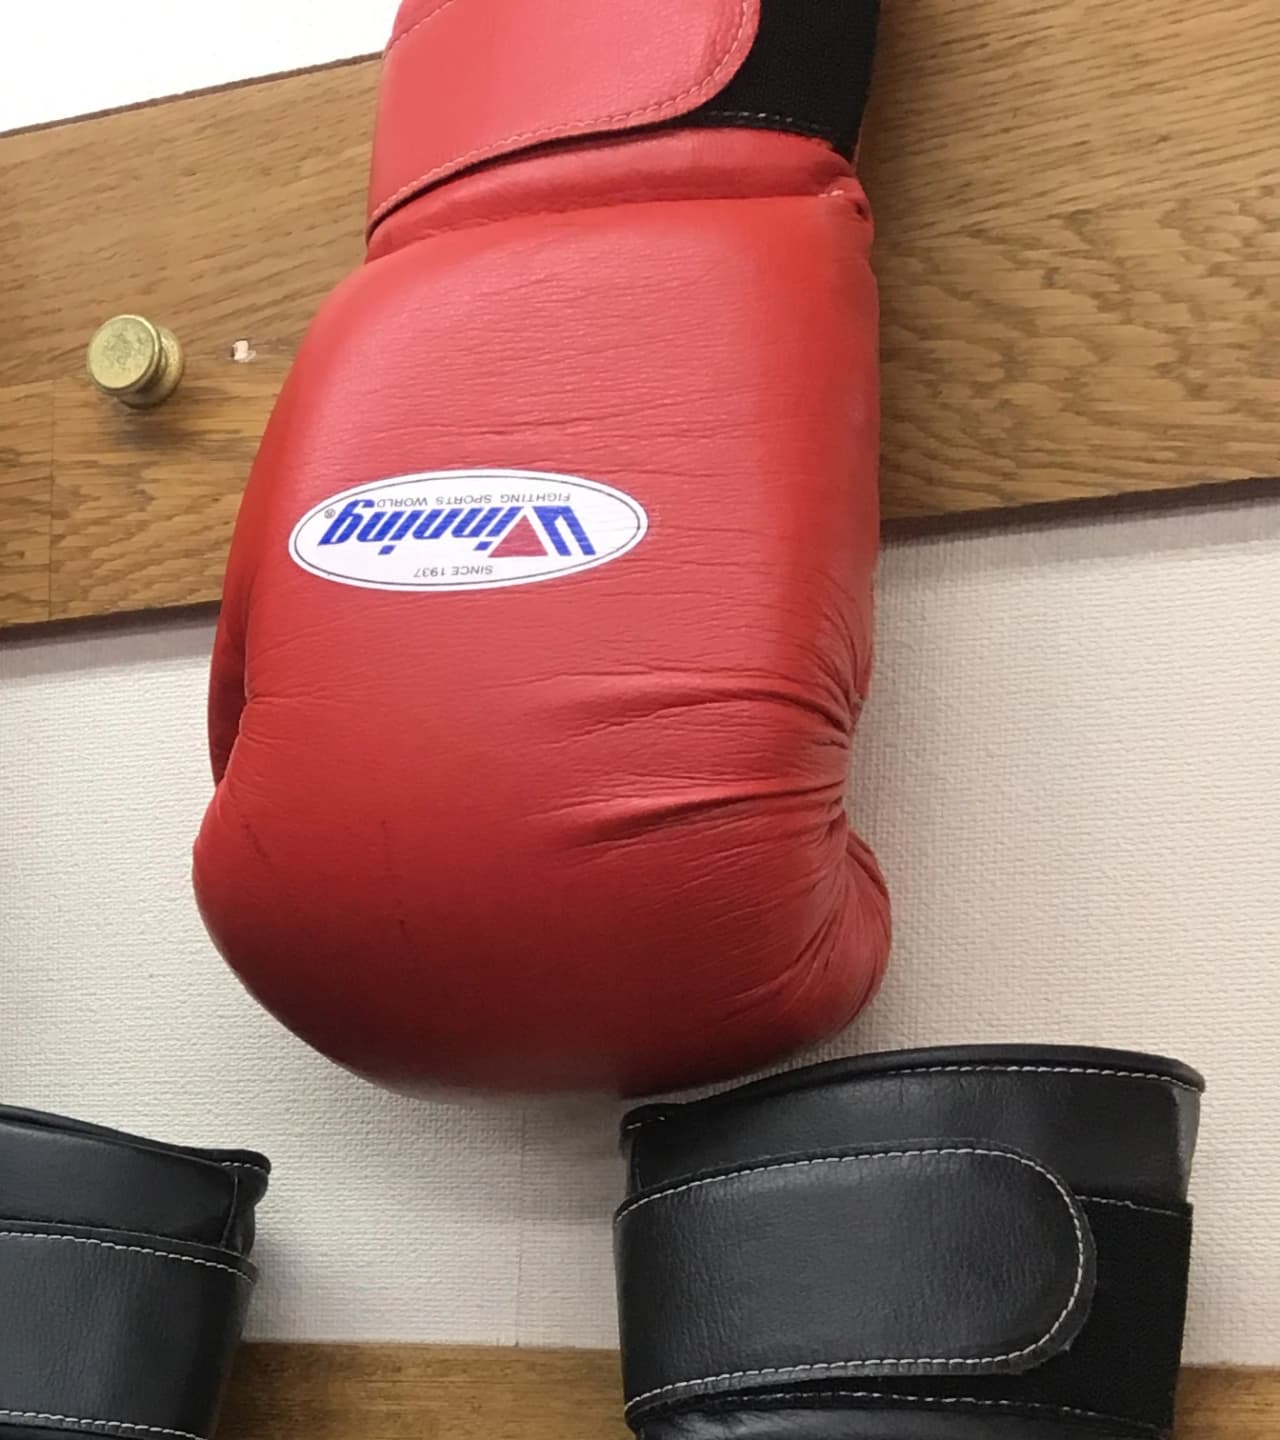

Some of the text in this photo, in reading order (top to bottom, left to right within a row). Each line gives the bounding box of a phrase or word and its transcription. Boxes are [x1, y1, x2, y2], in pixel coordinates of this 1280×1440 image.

[377, 492, 571, 508] FIGHTING SPORTS WORLD
[317, 499, 597, 558] Winning
[413, 565, 493, 579] SINCE 1937
